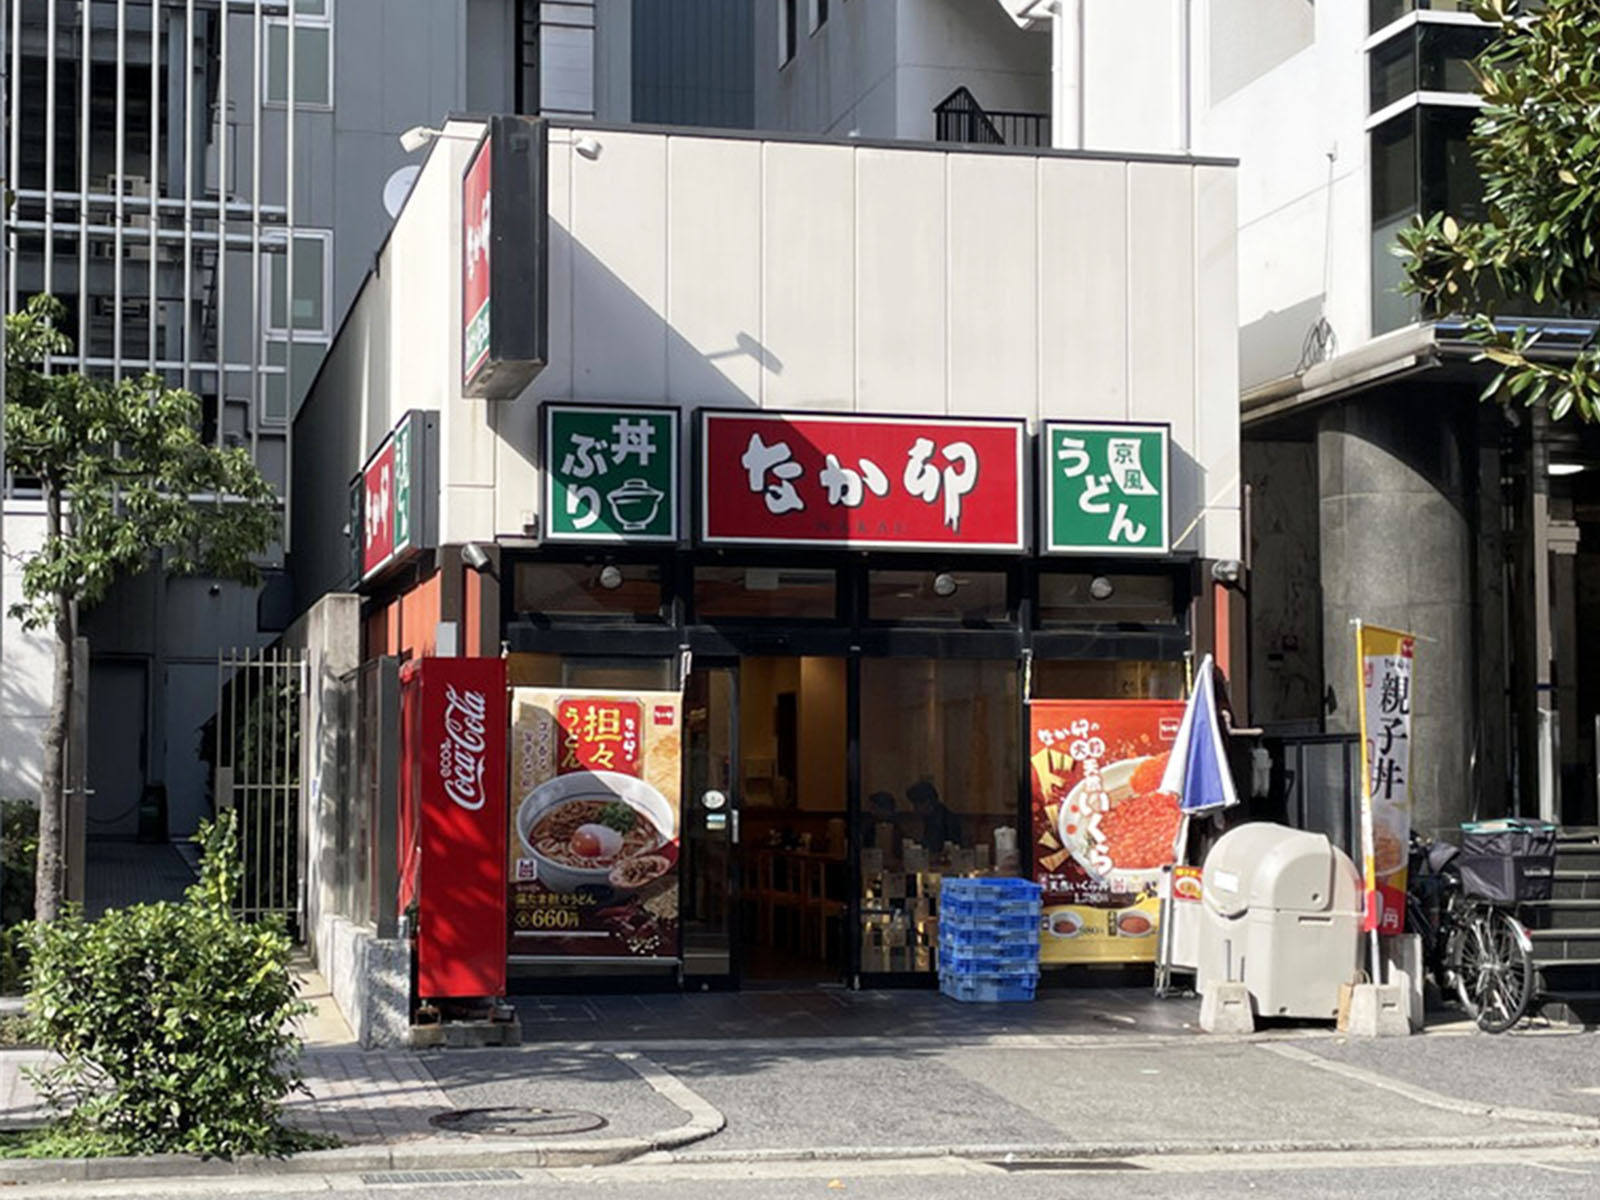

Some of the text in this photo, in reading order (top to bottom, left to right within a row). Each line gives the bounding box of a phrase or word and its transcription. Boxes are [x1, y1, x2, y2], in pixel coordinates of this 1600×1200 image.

[741, 432, 979, 535] なか卯
[1057, 437, 1148, 543] うどん
[1112, 443, 1144, 491] 京風
[560, 706, 582, 769] うどん
[583, 705, 623, 769] 担々
[1371, 672, 1411, 800] 親子丼
